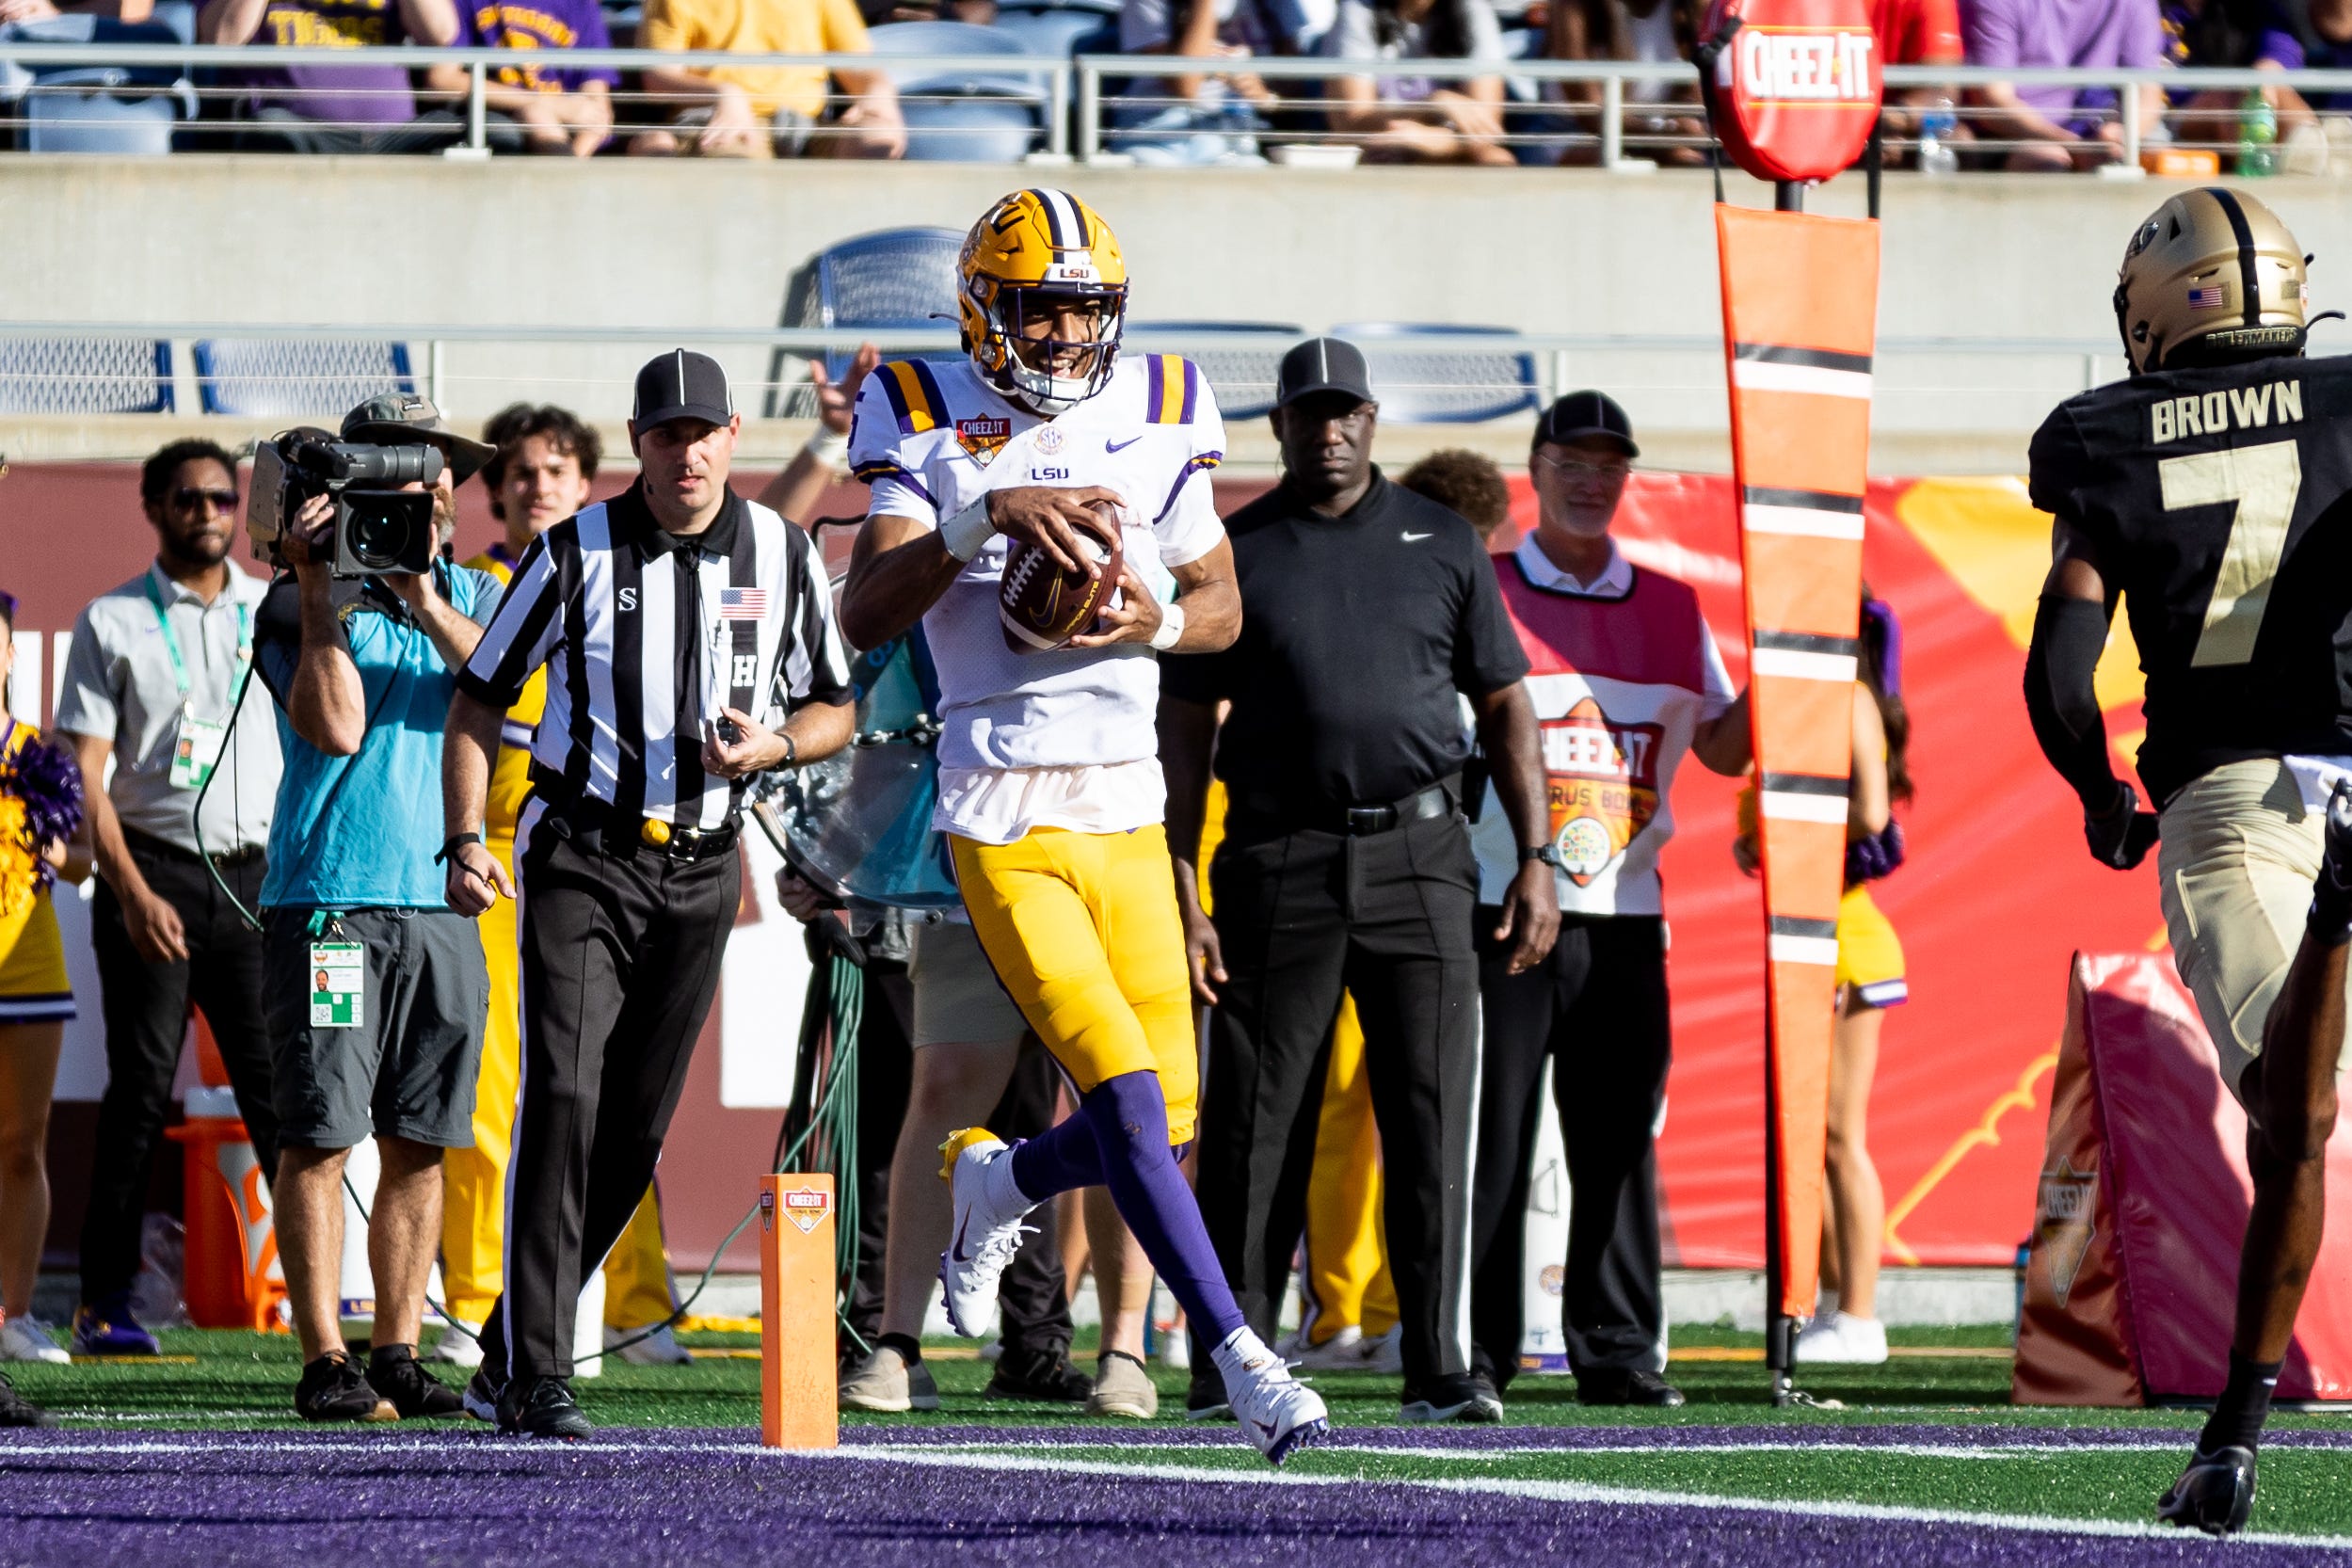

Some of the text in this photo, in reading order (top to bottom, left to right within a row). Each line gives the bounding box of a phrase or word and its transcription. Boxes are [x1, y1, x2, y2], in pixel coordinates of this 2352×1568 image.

[1060, 268, 1089, 279] LSU
[2152, 380, 2304, 444] BROWN
[1032, 467, 1069, 481] LSU
[2159, 440, 2302, 668] 7
[731, 654, 758, 688] H
